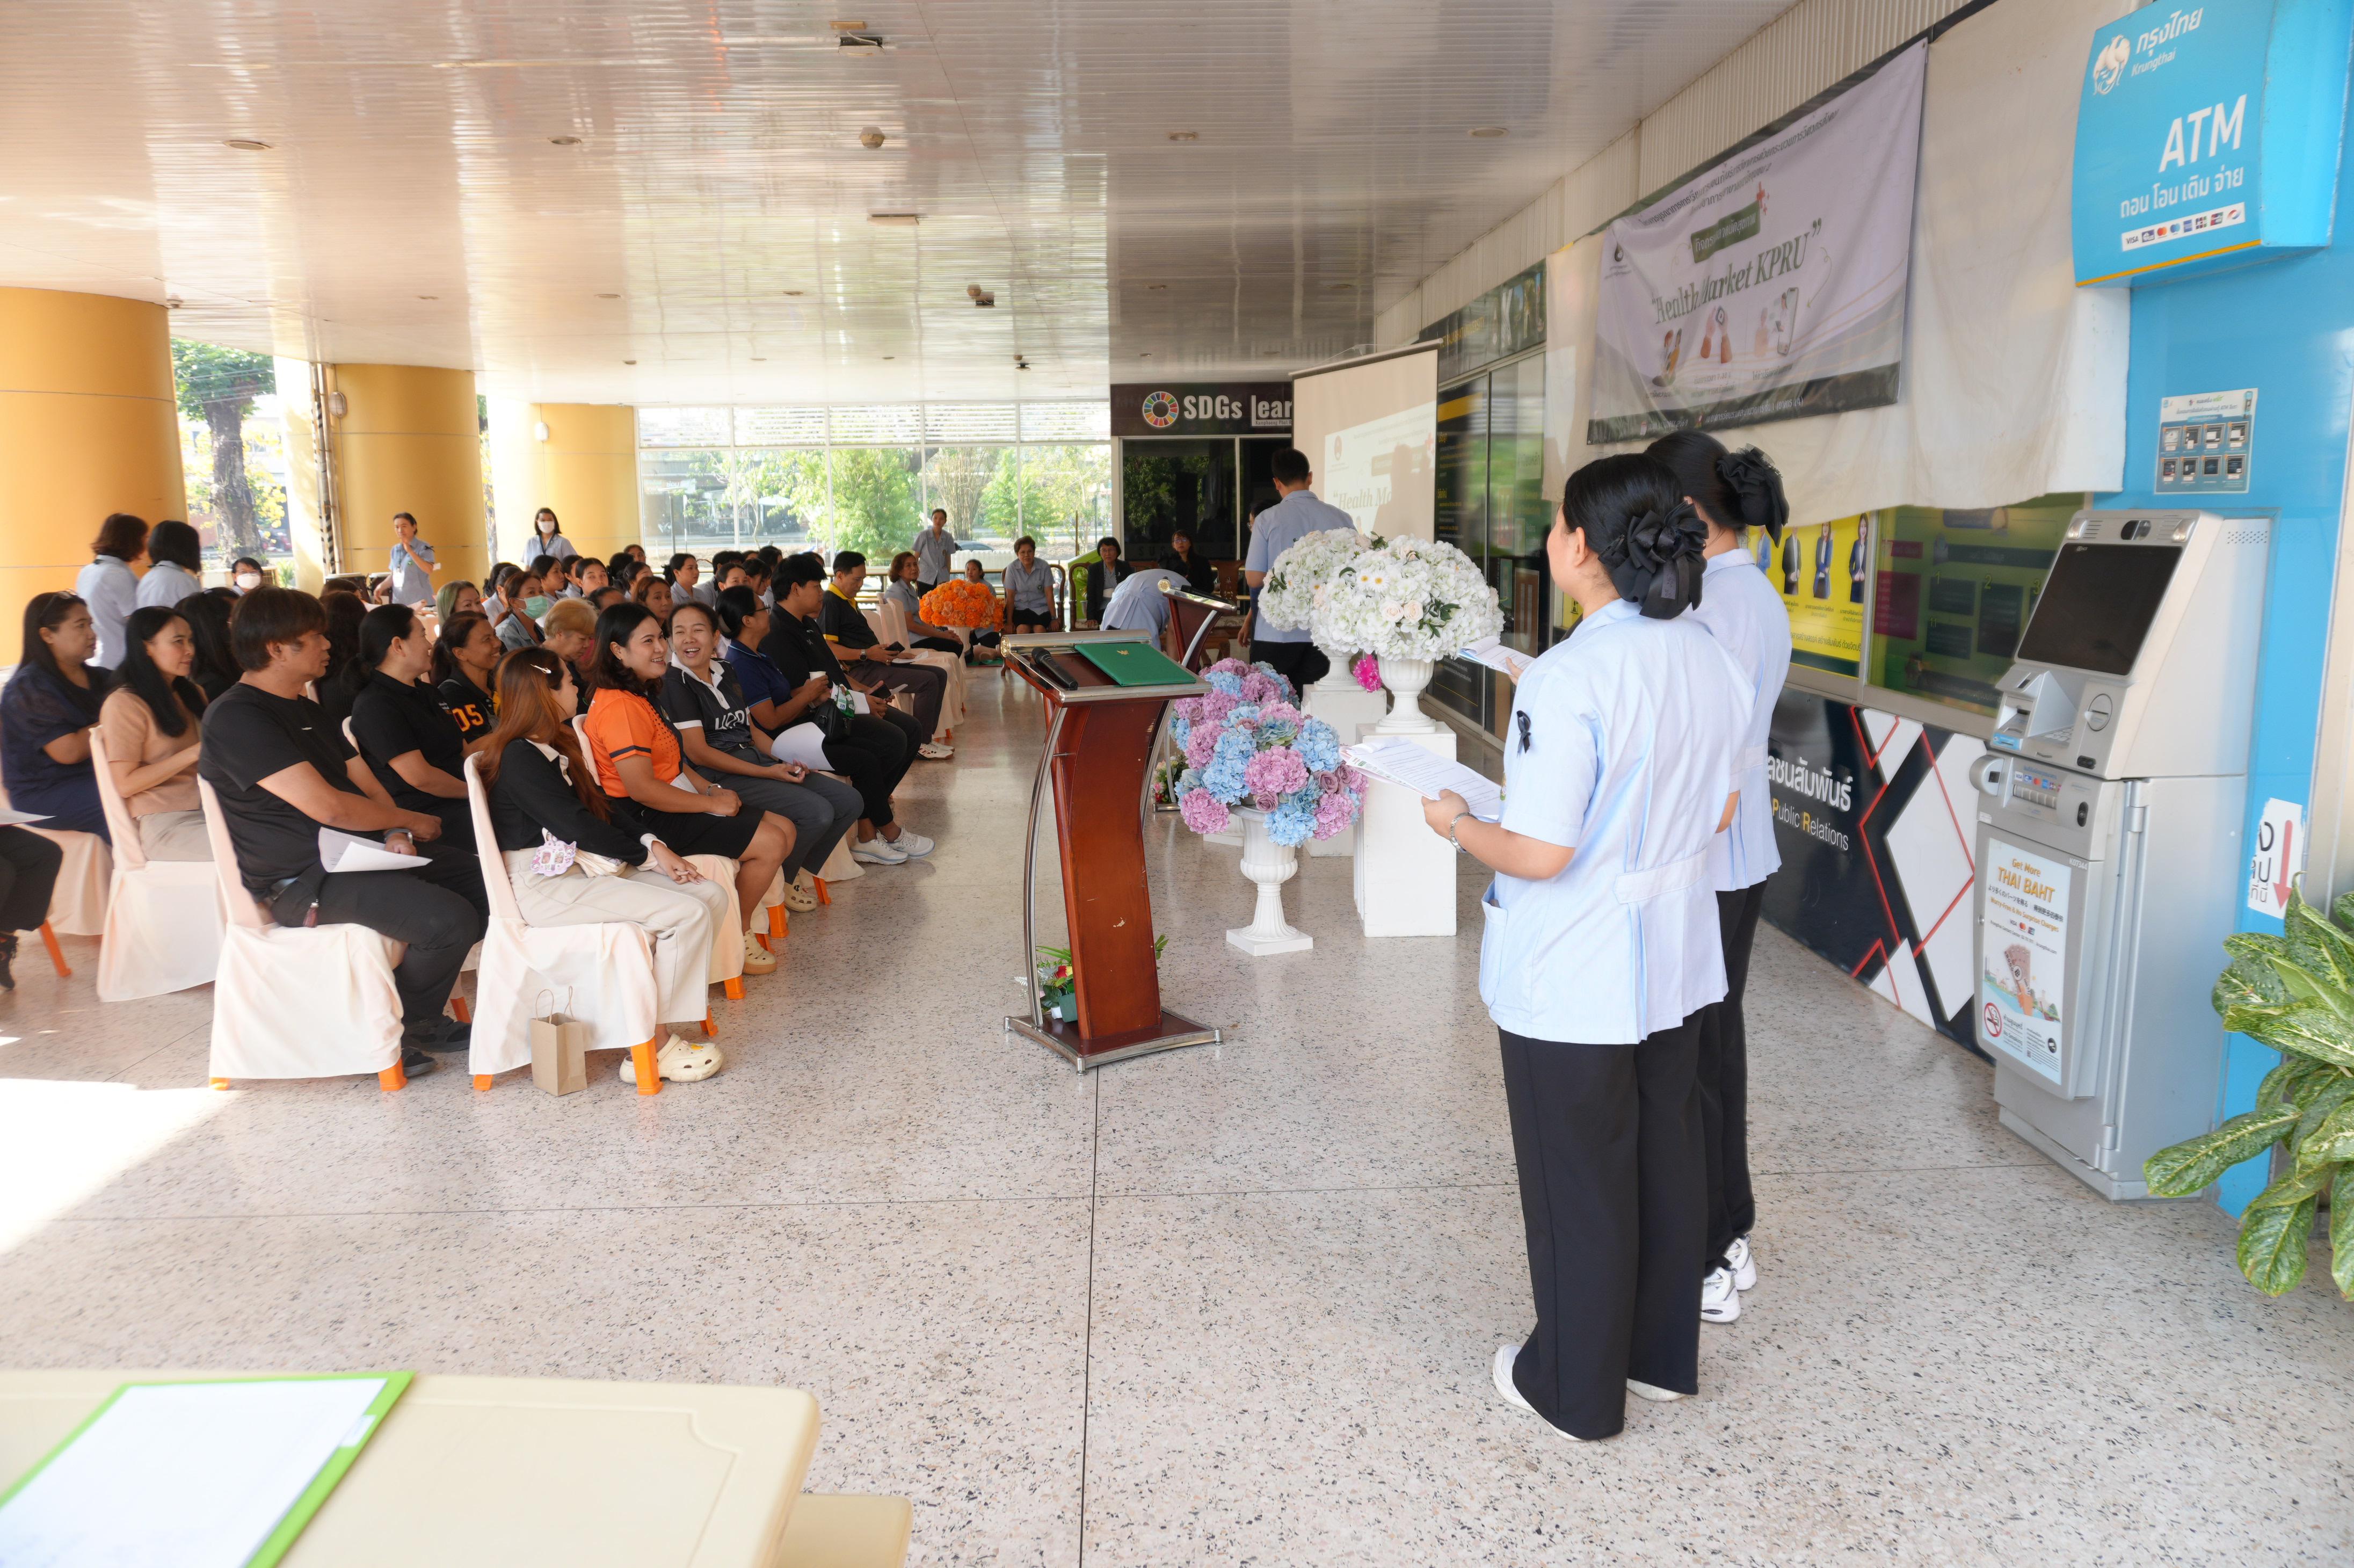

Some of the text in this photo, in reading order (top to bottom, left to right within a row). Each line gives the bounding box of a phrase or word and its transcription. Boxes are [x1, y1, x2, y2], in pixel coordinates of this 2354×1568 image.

[2135, 7, 2203, 56] กรุงไทย
[2131, 48, 2176, 77] Krungthai
[2158, 94, 2247, 173] ATM
[2120, 165, 2244, 219] ถอน โอน เติม จ่าย
[2126, 236, 2139, 244] VISA
[1183, 395, 1243, 419] SDGs
[1985, 575, 1992, 589] 2
[1772, 798, 1849, 851] Public Relations
[2012, 858, 2041, 877] Get More
[1997, 866, 2055, 903] THAI BAHT
